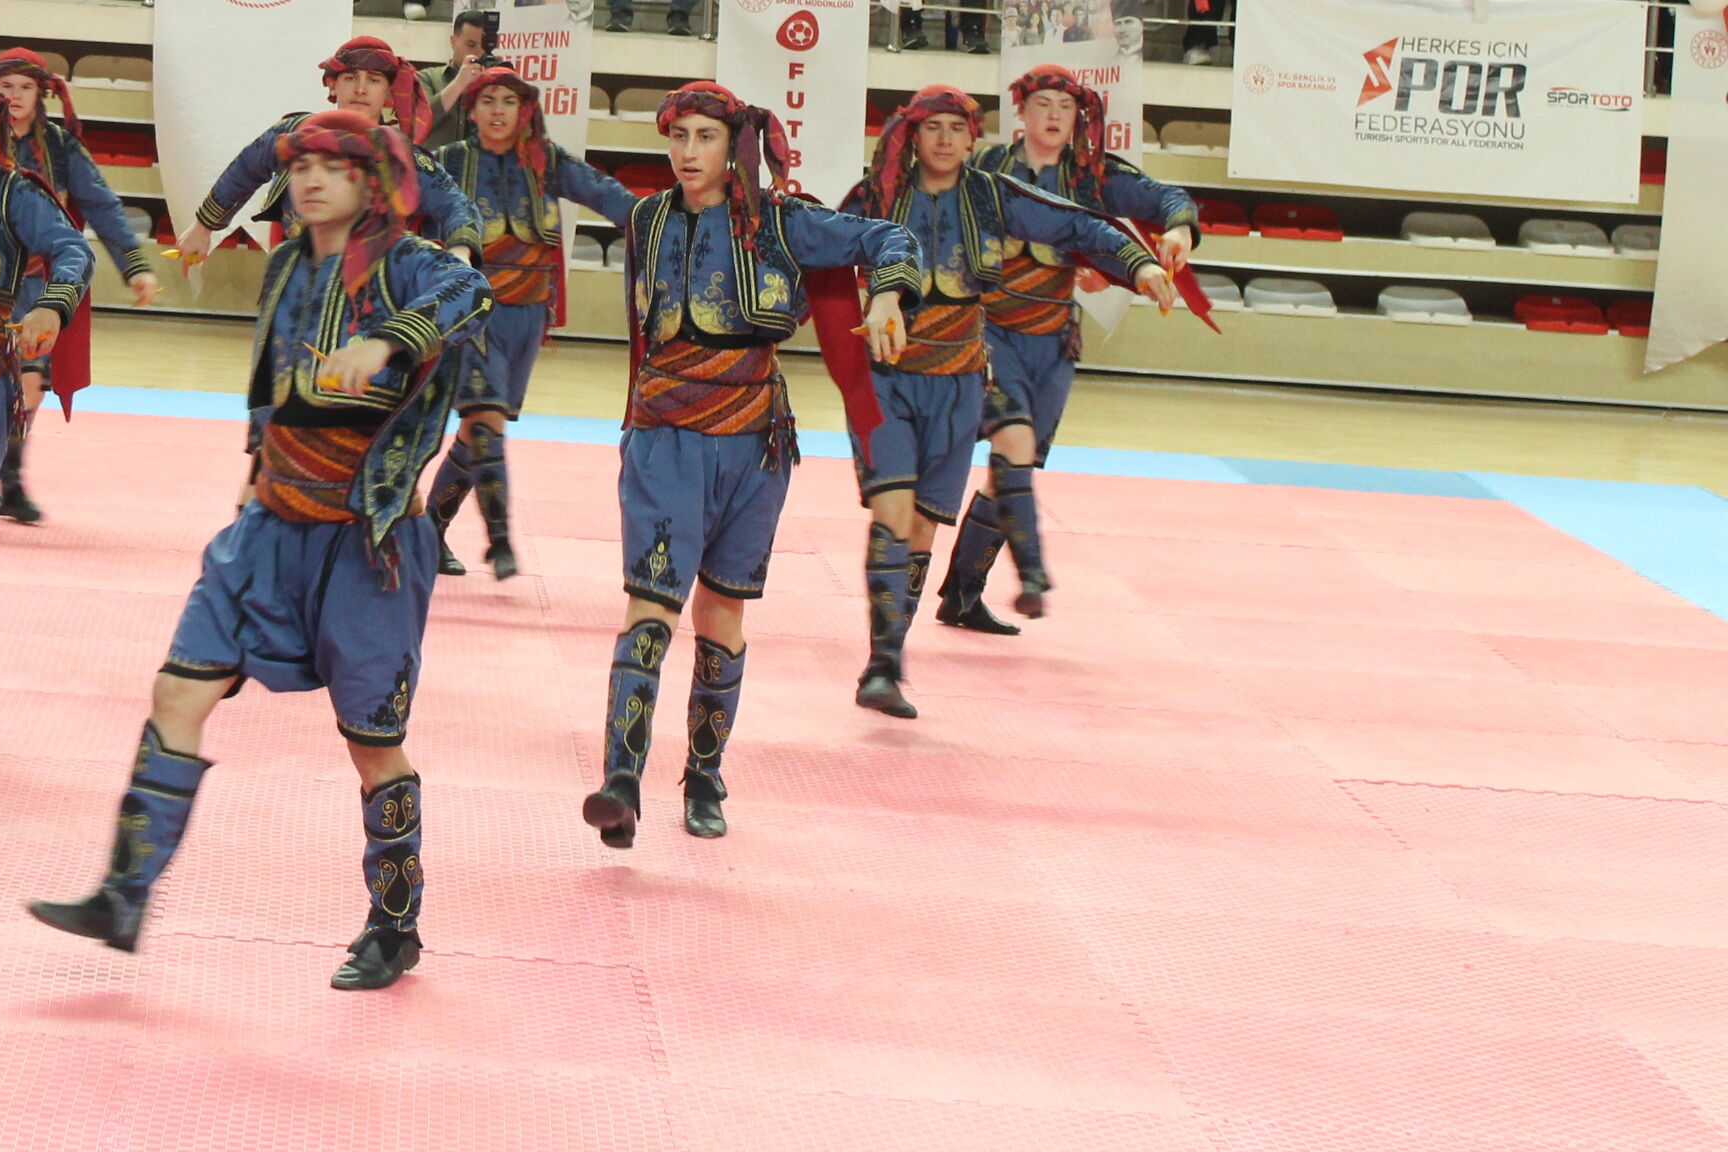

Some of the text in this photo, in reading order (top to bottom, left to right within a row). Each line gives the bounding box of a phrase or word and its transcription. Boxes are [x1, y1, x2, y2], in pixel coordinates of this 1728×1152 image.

[1401, 36, 1528, 58] HERKES İÇİN
[1354, 113, 1525, 140] FEDERASYONU
[1355, 132, 1524, 150] TURKISH SPORTS FOR ALL FEDERATION
